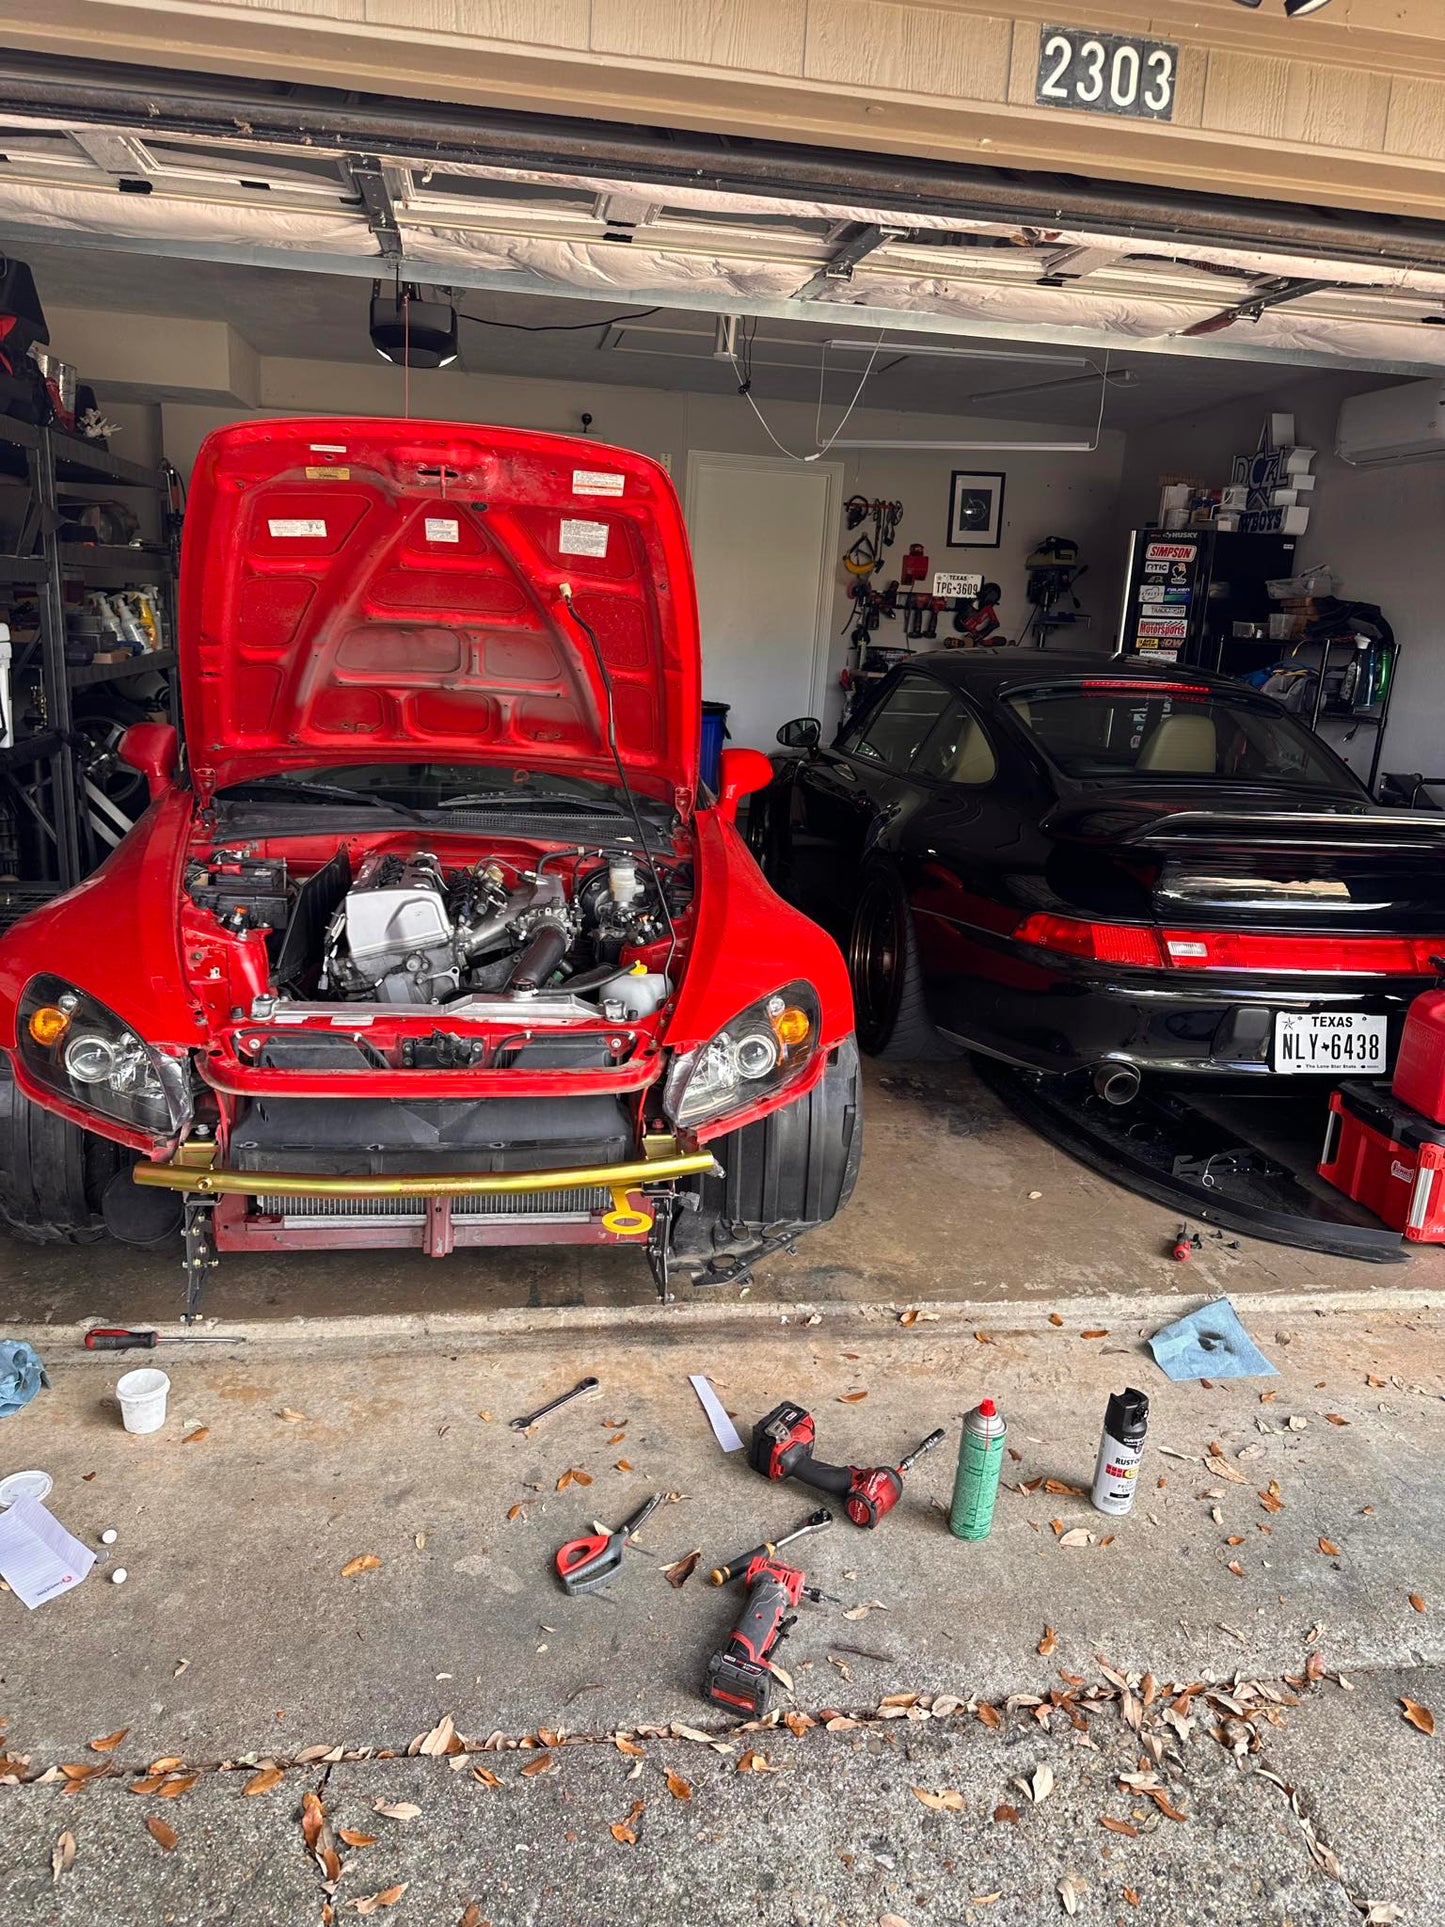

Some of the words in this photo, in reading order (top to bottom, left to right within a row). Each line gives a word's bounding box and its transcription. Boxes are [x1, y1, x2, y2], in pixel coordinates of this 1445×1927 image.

[1042, 36, 1173, 111] 2303
[1240, 509, 1282, 532] WBOYS
[1172, 531, 1198, 539] HUSKY
[1150, 546, 1192, 559] SIMPSON
[1147, 563, 1168, 571] RTIC
[1312, 1016, 1353, 1028] TEXAS
